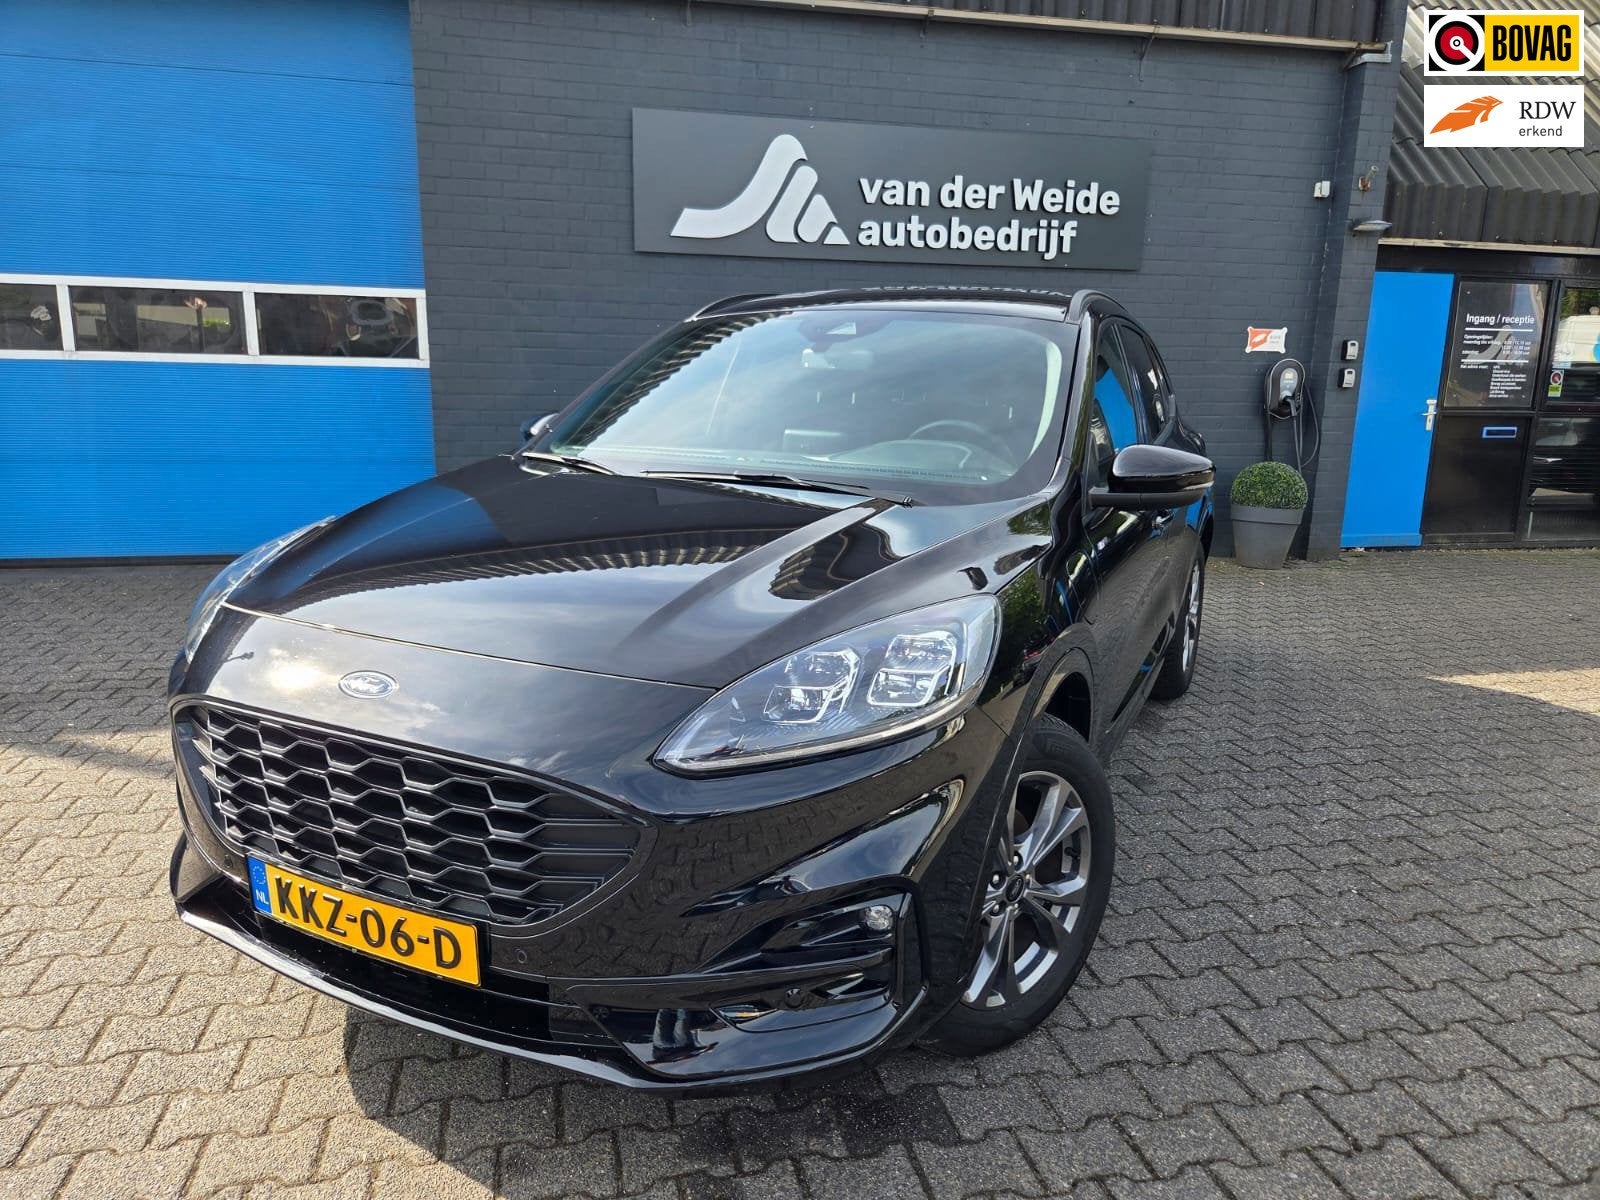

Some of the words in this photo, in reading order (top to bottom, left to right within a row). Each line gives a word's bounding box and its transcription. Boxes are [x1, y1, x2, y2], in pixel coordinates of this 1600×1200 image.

[859, 177, 931, 207] van
[939, 175, 1006, 210] der
[1012, 178, 1121, 216] Weide
[857, 215, 1079, 261] autobedrijf
[1466, 313, 1496, 326] Ingang
[1496, 313, 1501, 324] /
[1501, 314, 1535, 326] receptie
[255, 889, 270, 906] NL
[274, 875, 462, 970] KKZ-06-D
